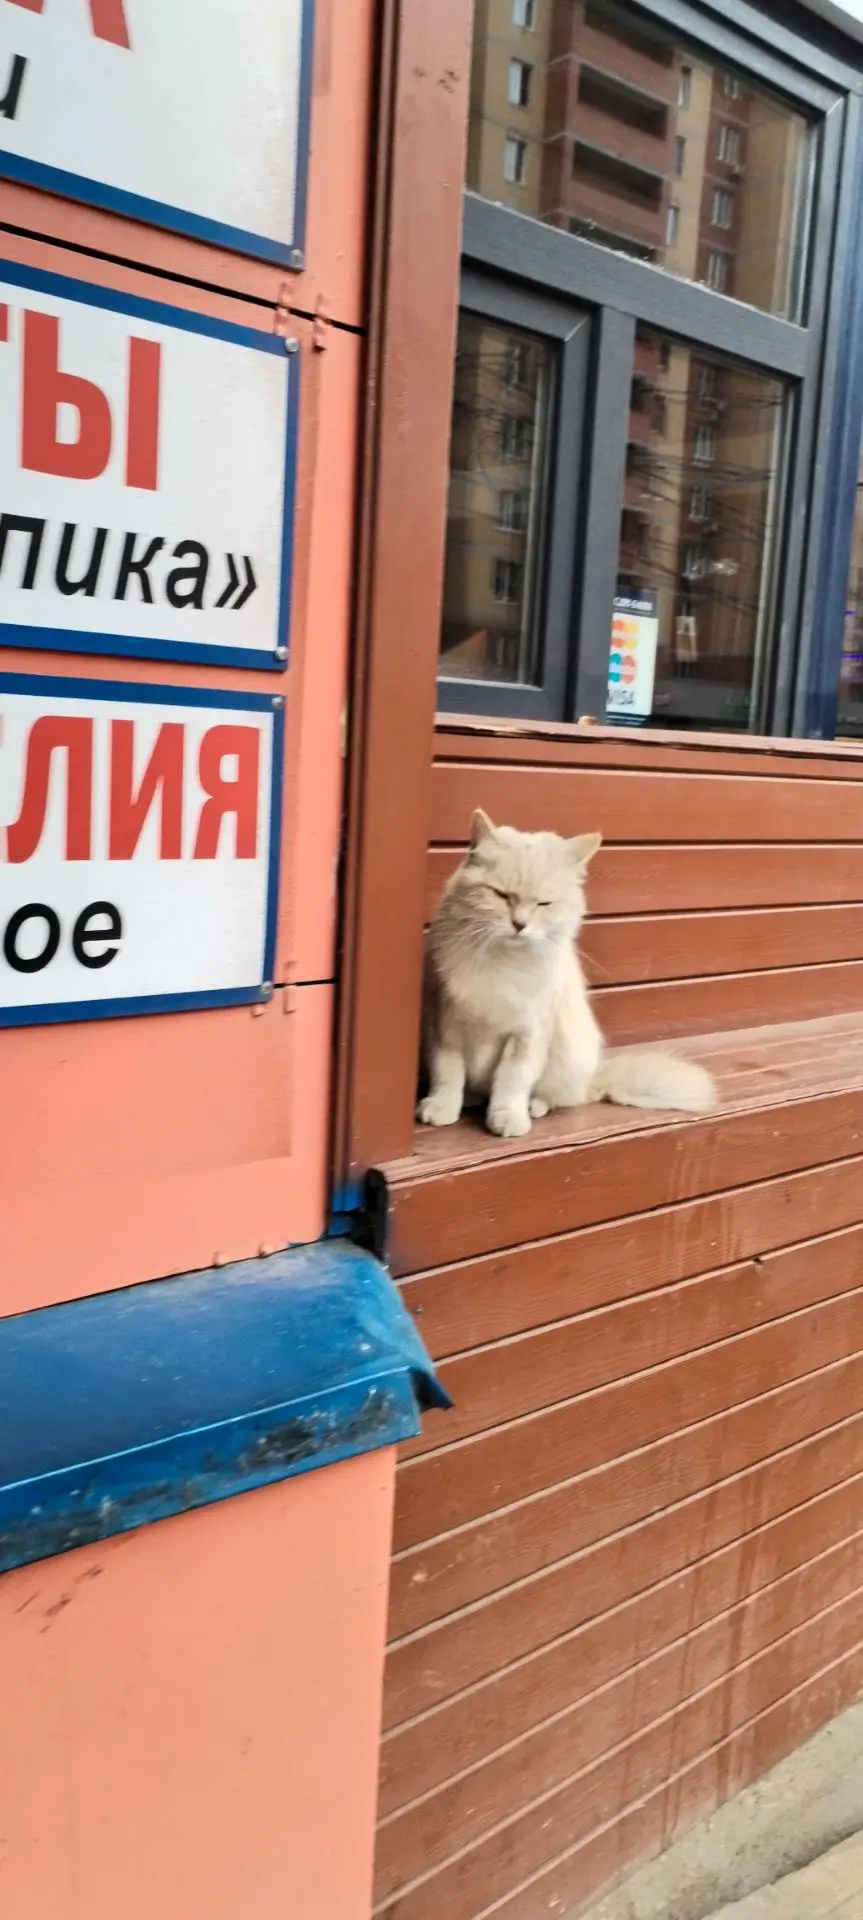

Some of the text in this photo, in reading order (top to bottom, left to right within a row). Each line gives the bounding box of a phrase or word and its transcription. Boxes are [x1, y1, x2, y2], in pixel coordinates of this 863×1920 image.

[0, 305, 161, 491] Ы
[0, 513, 257, 610] пика»
[0, 714, 260, 863] ЛИЯ
[4, 901, 123, 973] ое
